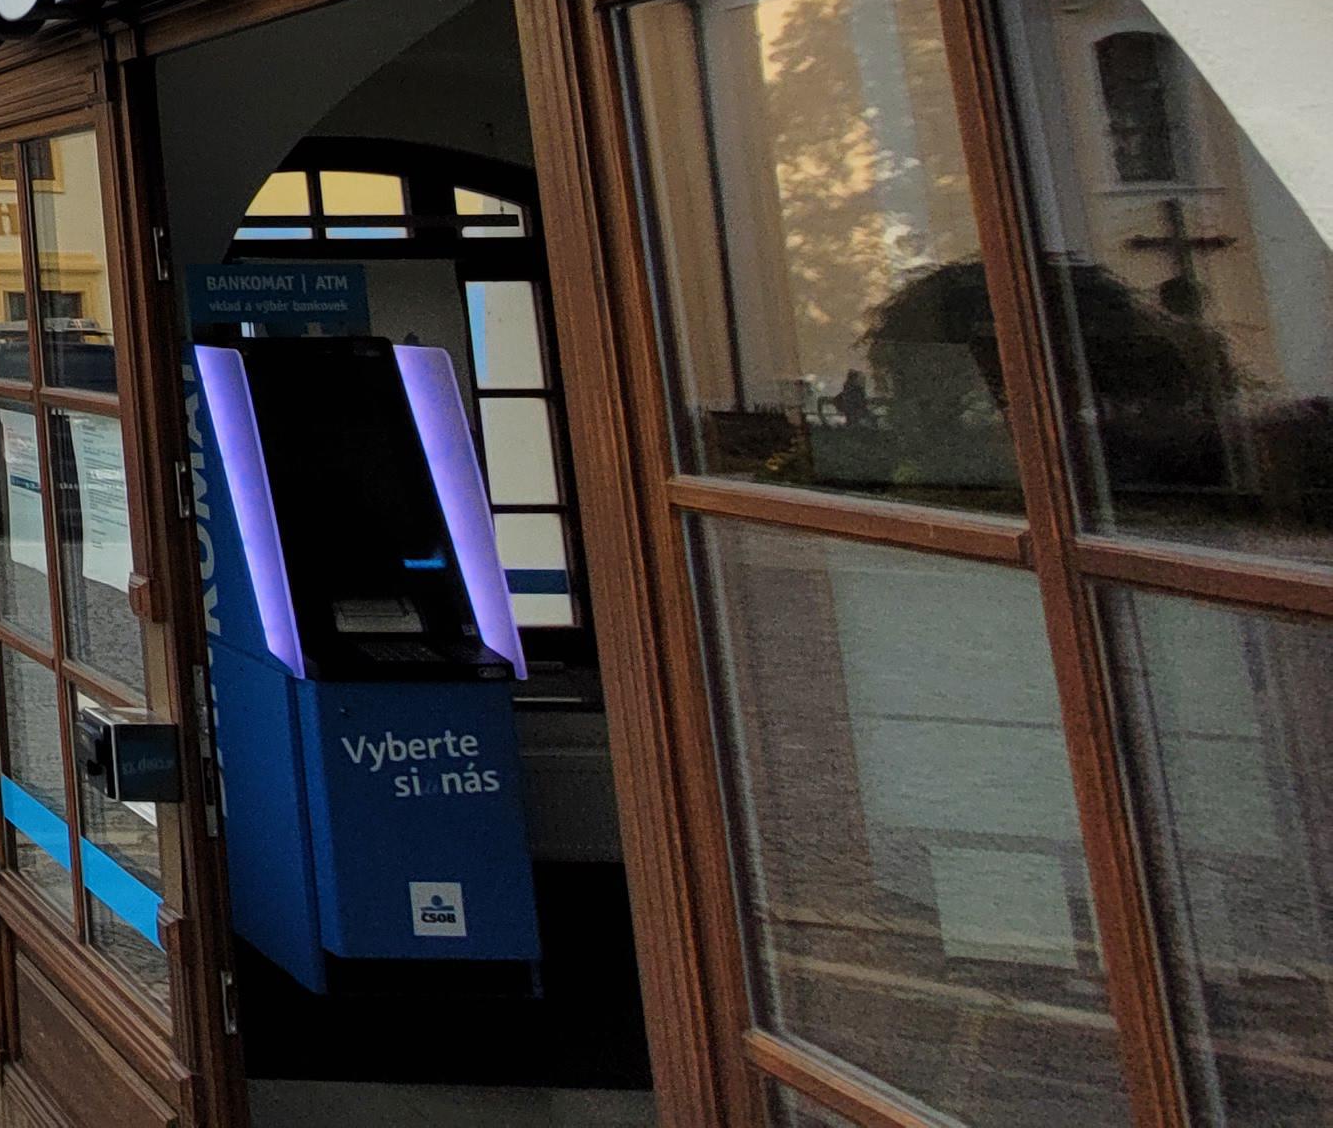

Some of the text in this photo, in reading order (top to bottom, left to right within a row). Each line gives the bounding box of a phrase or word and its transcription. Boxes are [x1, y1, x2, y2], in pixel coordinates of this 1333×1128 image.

[206, 275, 348, 291] BANKOMAT ATM
[341, 730, 480, 772] Vyberte
[394, 763, 501, 797] si nás
[421, 911, 457, 923] ČSOB
